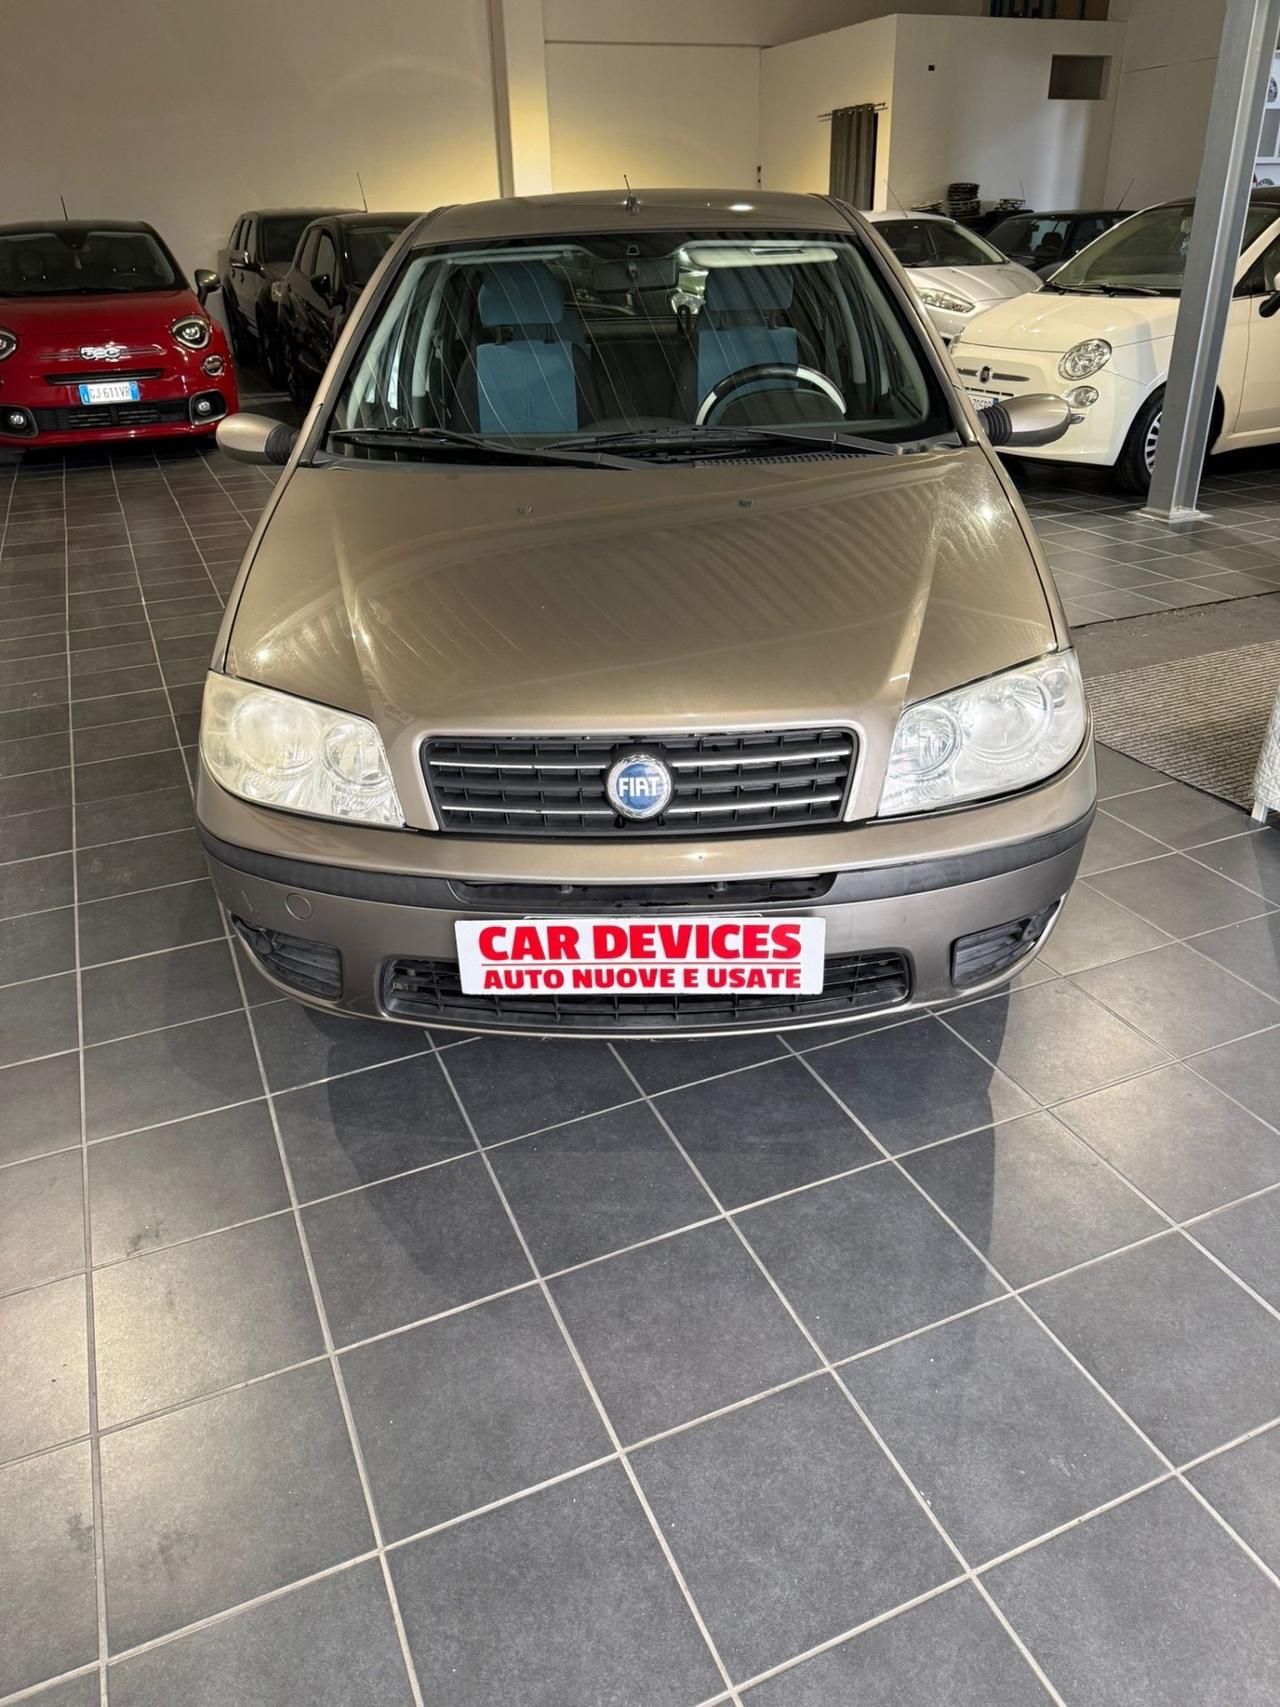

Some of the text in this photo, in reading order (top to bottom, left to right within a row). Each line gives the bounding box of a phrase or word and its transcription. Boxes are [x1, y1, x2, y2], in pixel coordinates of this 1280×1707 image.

[618, 776, 660, 797] FIAT
[478, 923, 801, 962] CAR DEVICES
[483, 967, 802, 990] AUTO NUOVE E USATE
